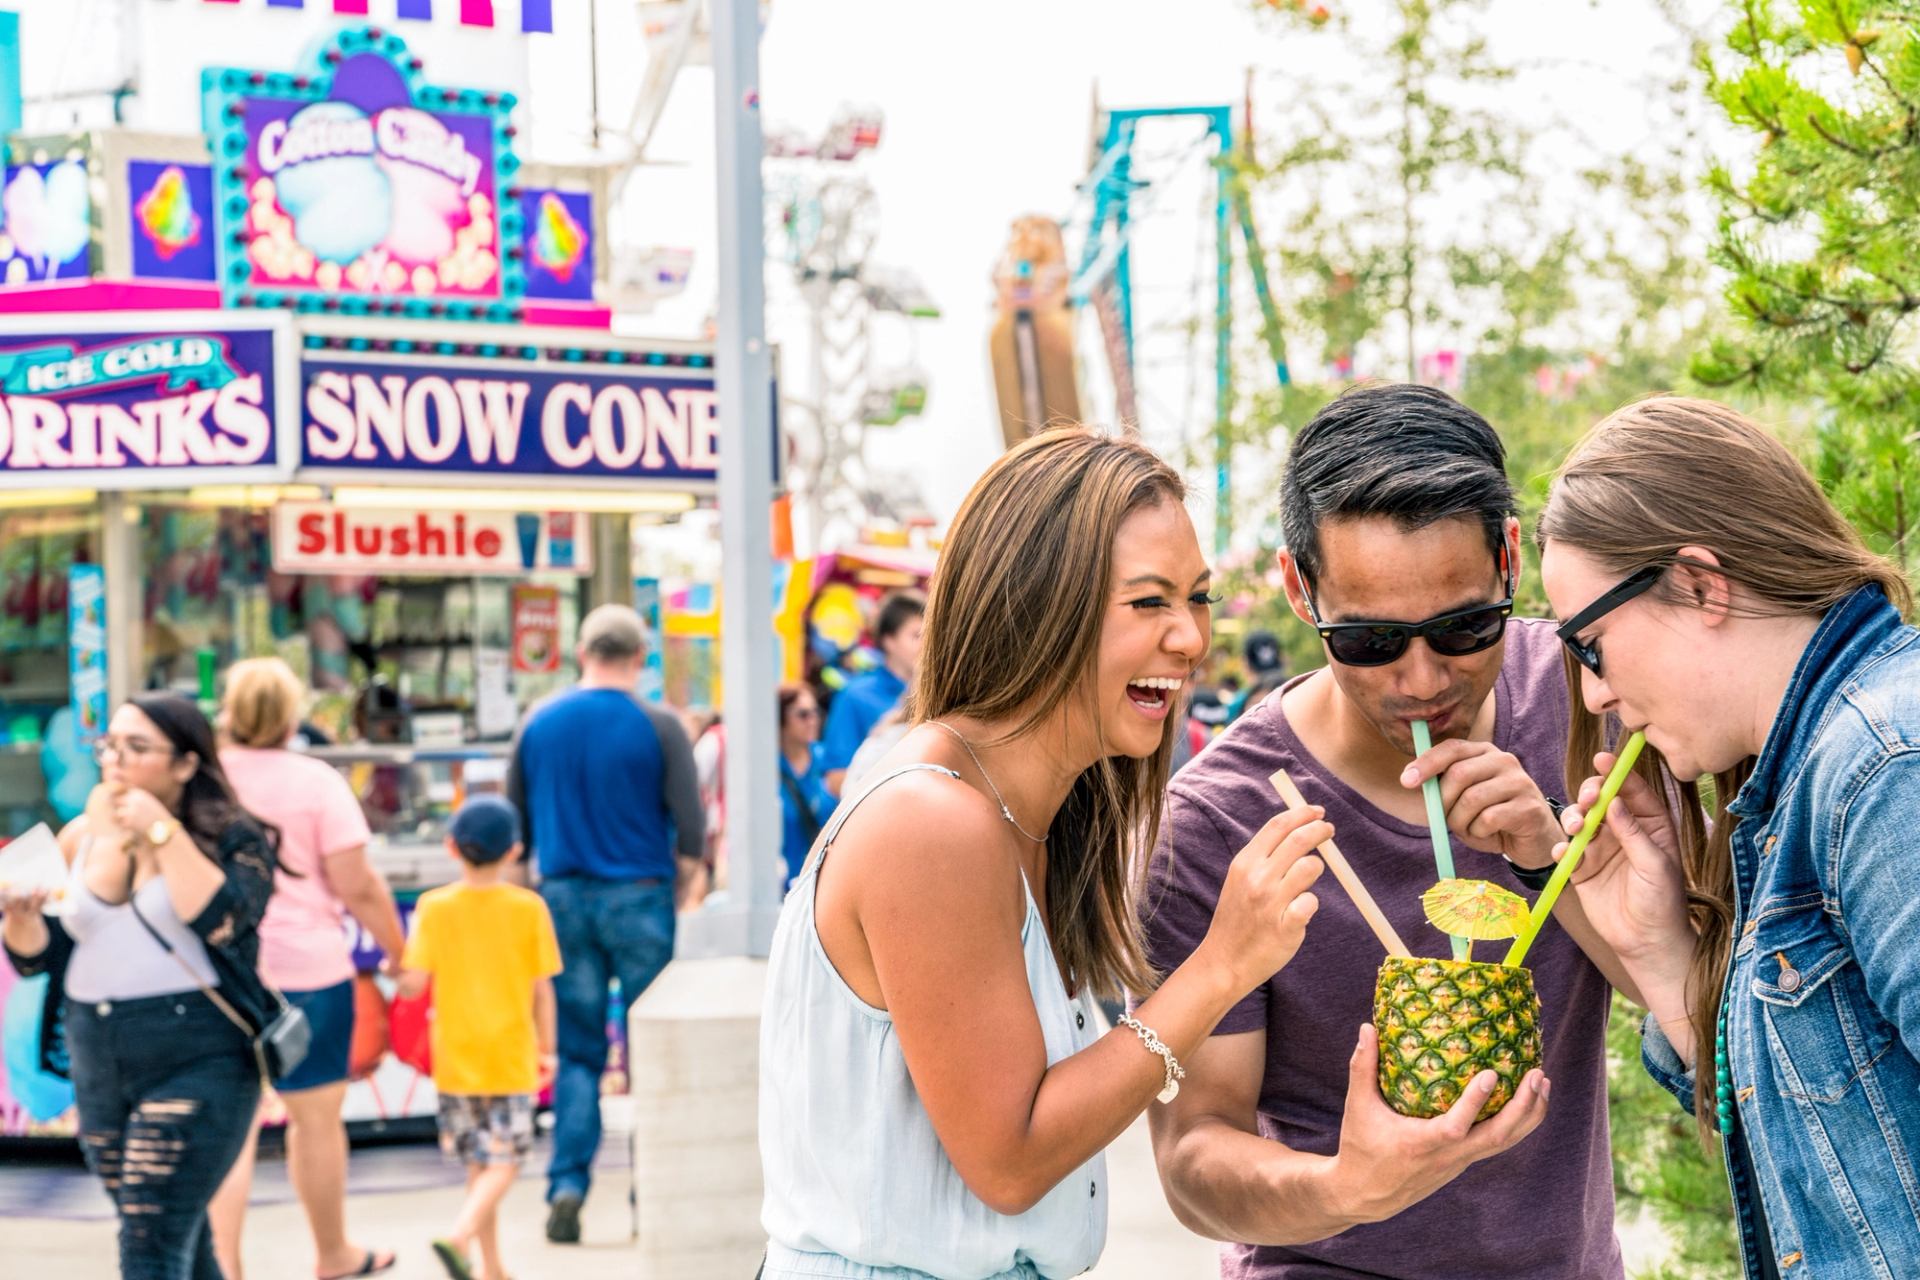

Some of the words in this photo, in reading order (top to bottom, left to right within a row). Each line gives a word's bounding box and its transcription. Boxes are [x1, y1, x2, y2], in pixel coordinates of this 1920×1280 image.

[27, 354, 96, 392] ICE
[102, 338, 214, 377] COLD
[0, 373, 270, 468] RINKS
[307, 372, 530, 464] SNOW
[297, 511, 502, 557] Slushie
